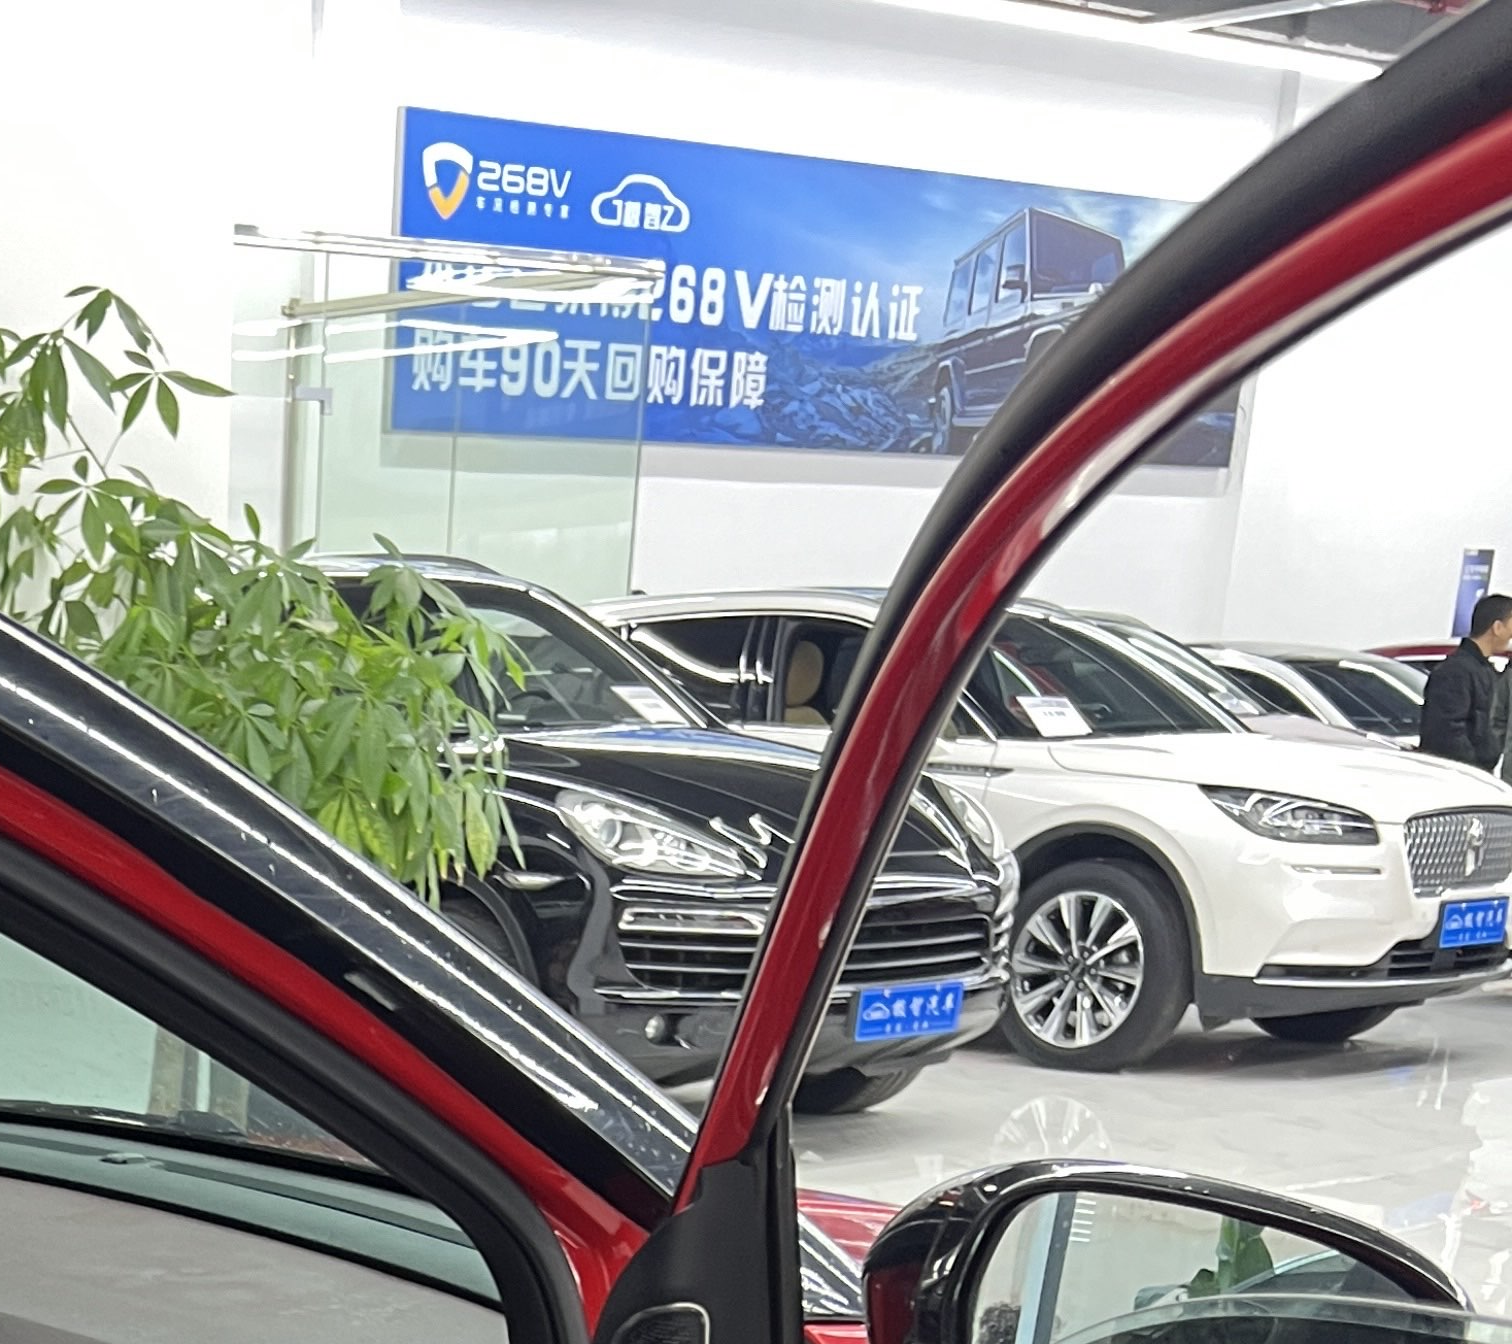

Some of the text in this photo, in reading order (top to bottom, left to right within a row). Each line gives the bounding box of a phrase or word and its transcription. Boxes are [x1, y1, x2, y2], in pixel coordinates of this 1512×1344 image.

[476, 160, 572, 199] 268V
[411, 327, 770, 409] 购车90天回购保障
